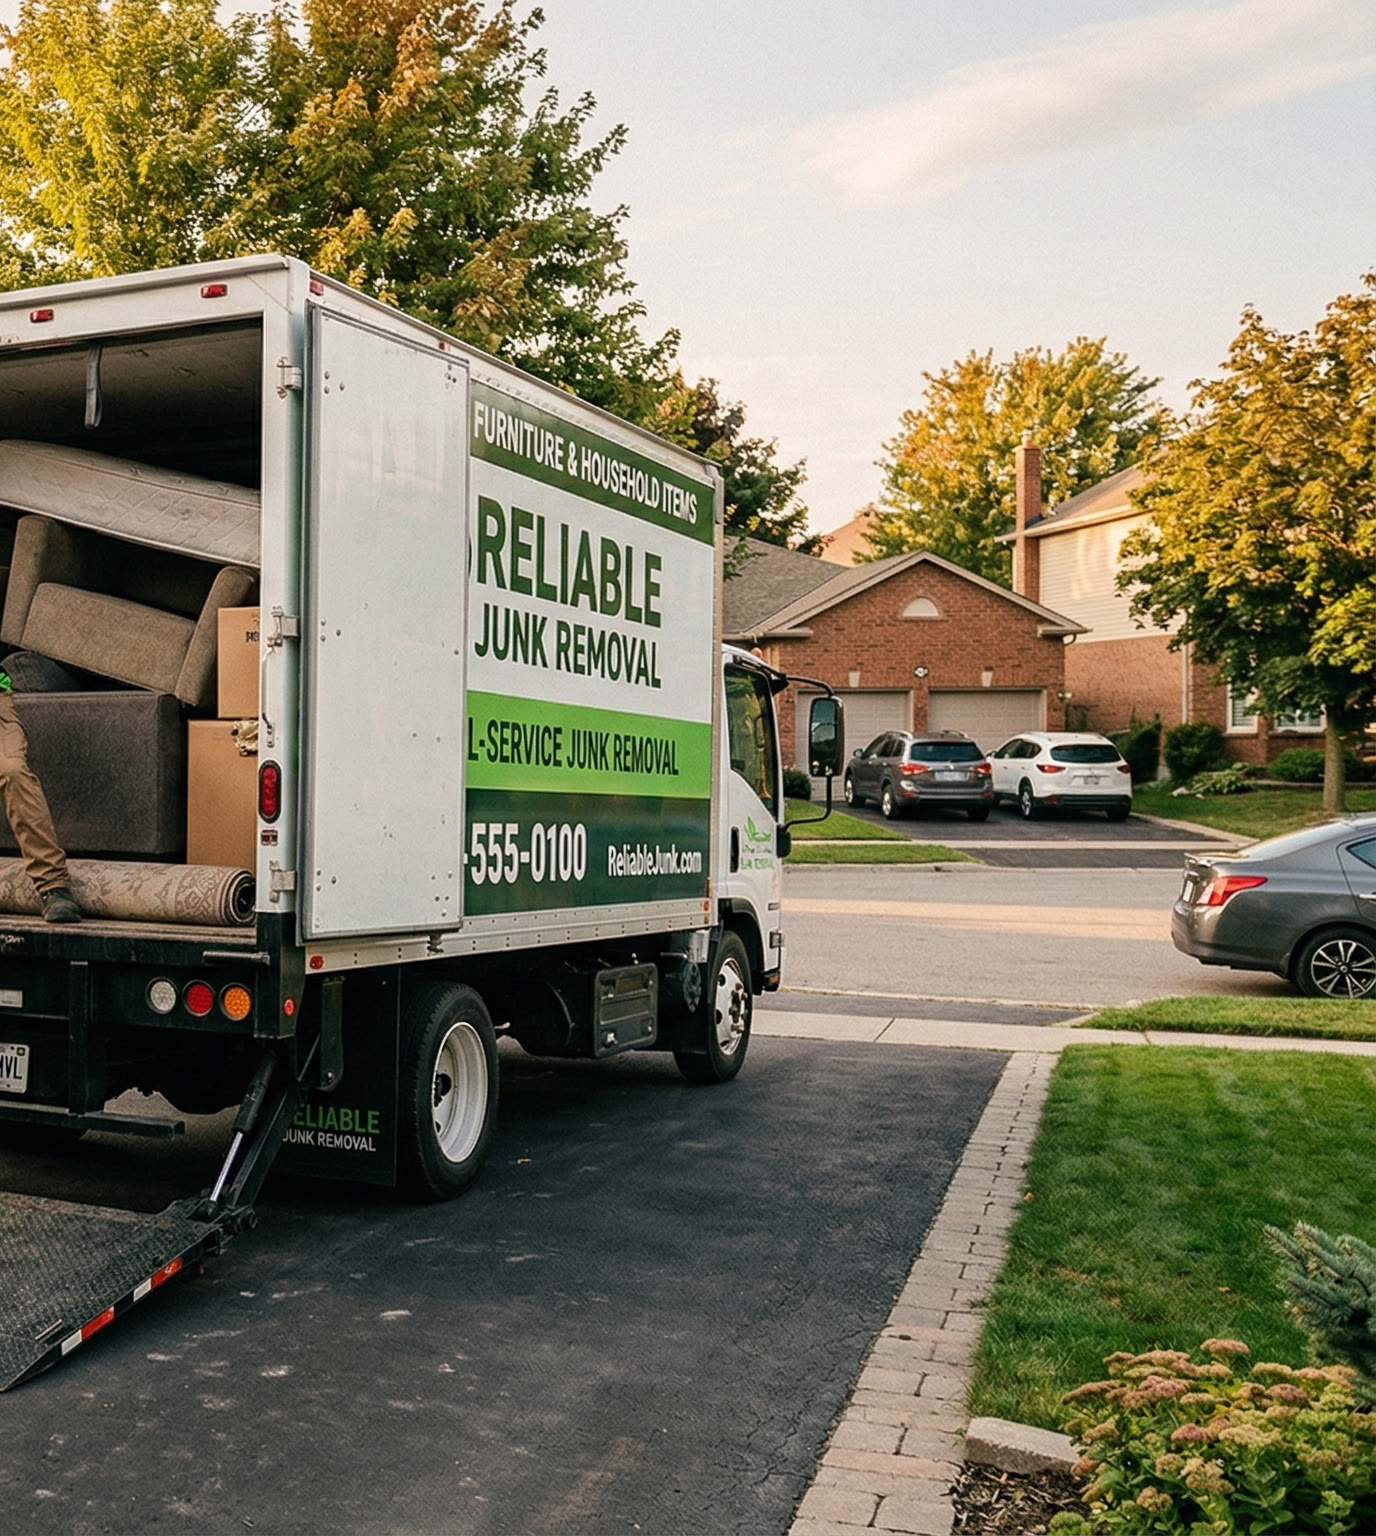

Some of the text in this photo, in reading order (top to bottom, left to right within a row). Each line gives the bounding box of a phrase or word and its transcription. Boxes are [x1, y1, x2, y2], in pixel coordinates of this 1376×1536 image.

[474, 401, 697, 524] FURNITURE & HOUSEHOLD ITEMS
[477, 494, 662, 628] RELIABLE
[474, 603, 662, 689] JUNK REMOVAL
[567, 729, 610, 771] JUNK
[613, 735, 679, 775] REMOVAL
[608, 844, 702, 877] ReliableJunk.com
[282, 1128, 376, 1152] JUNK REMOVAL
